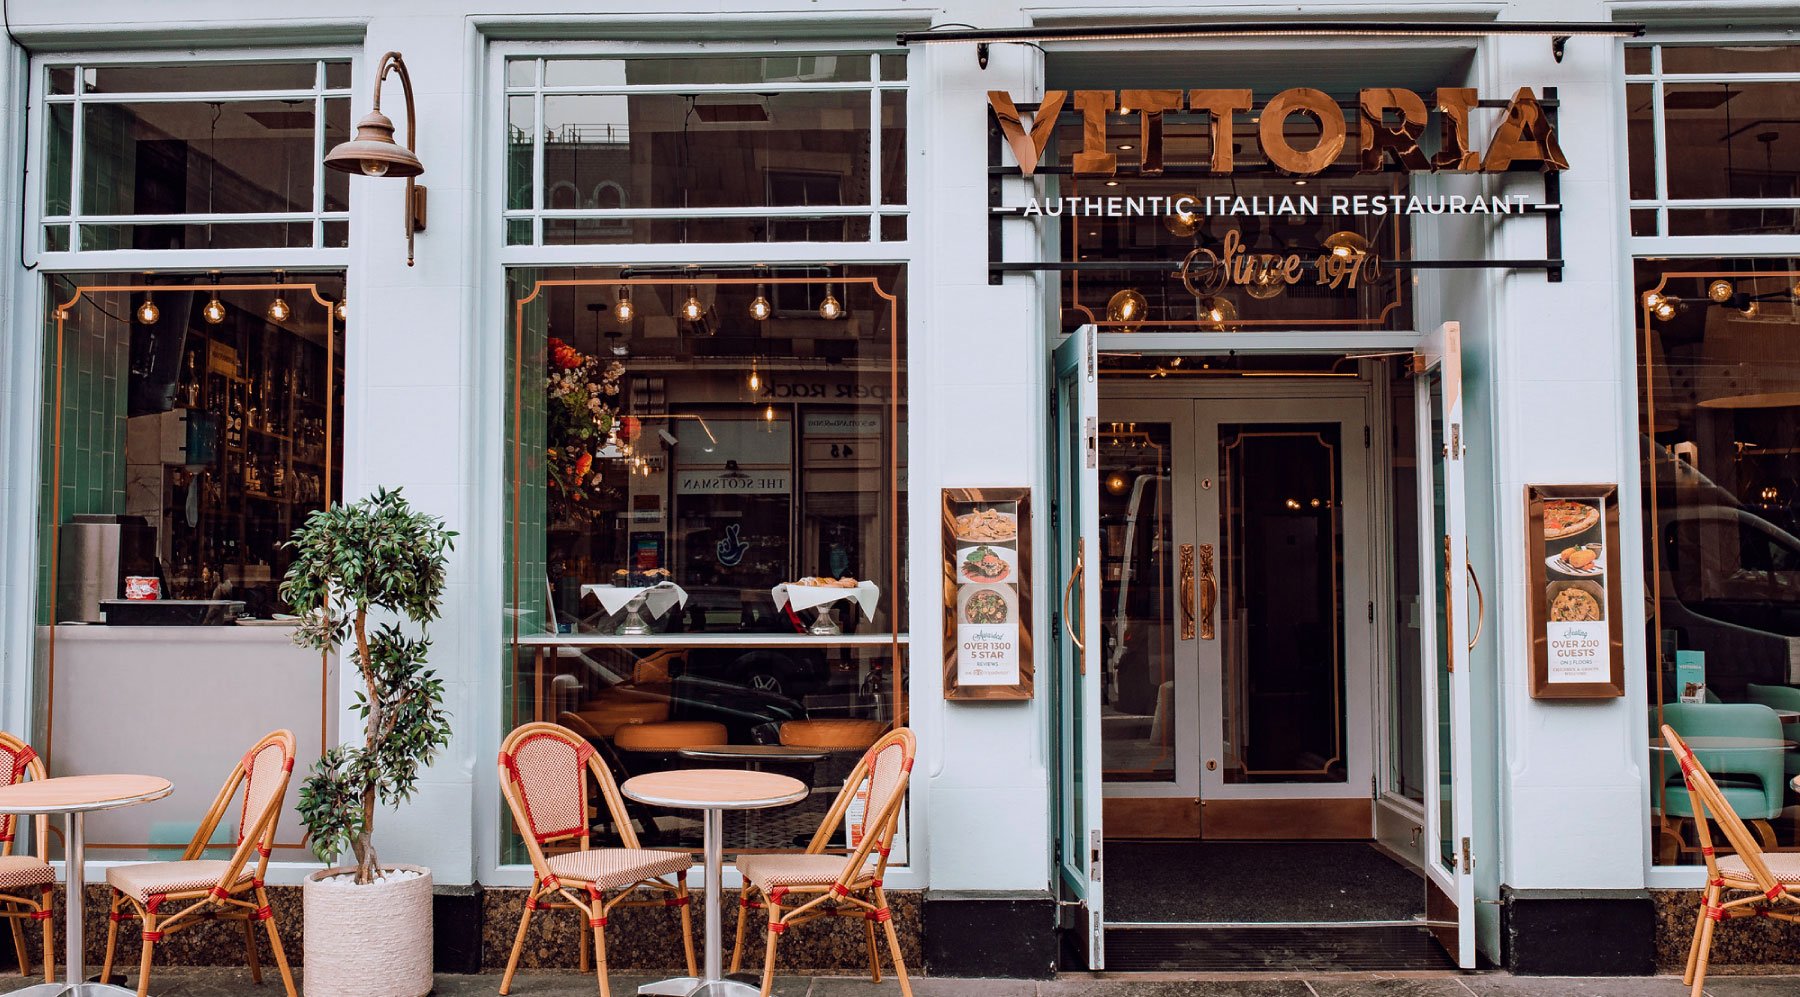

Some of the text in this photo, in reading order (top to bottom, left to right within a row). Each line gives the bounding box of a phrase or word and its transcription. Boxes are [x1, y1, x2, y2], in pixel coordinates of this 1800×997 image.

[986, 87, 1569, 176] VITTORIA
[1022, 194, 1530, 217] AUTHENTIC ITALIAN RESTAURANT
[1171, 229, 1383, 297] Since 1970
[963, 642, 1011, 650] OVER 1300
[1551, 639, 1600, 648] OVER 200
[971, 651, 1005, 659] 5 STAR
[1556, 648, 1596, 658] GUESTS
